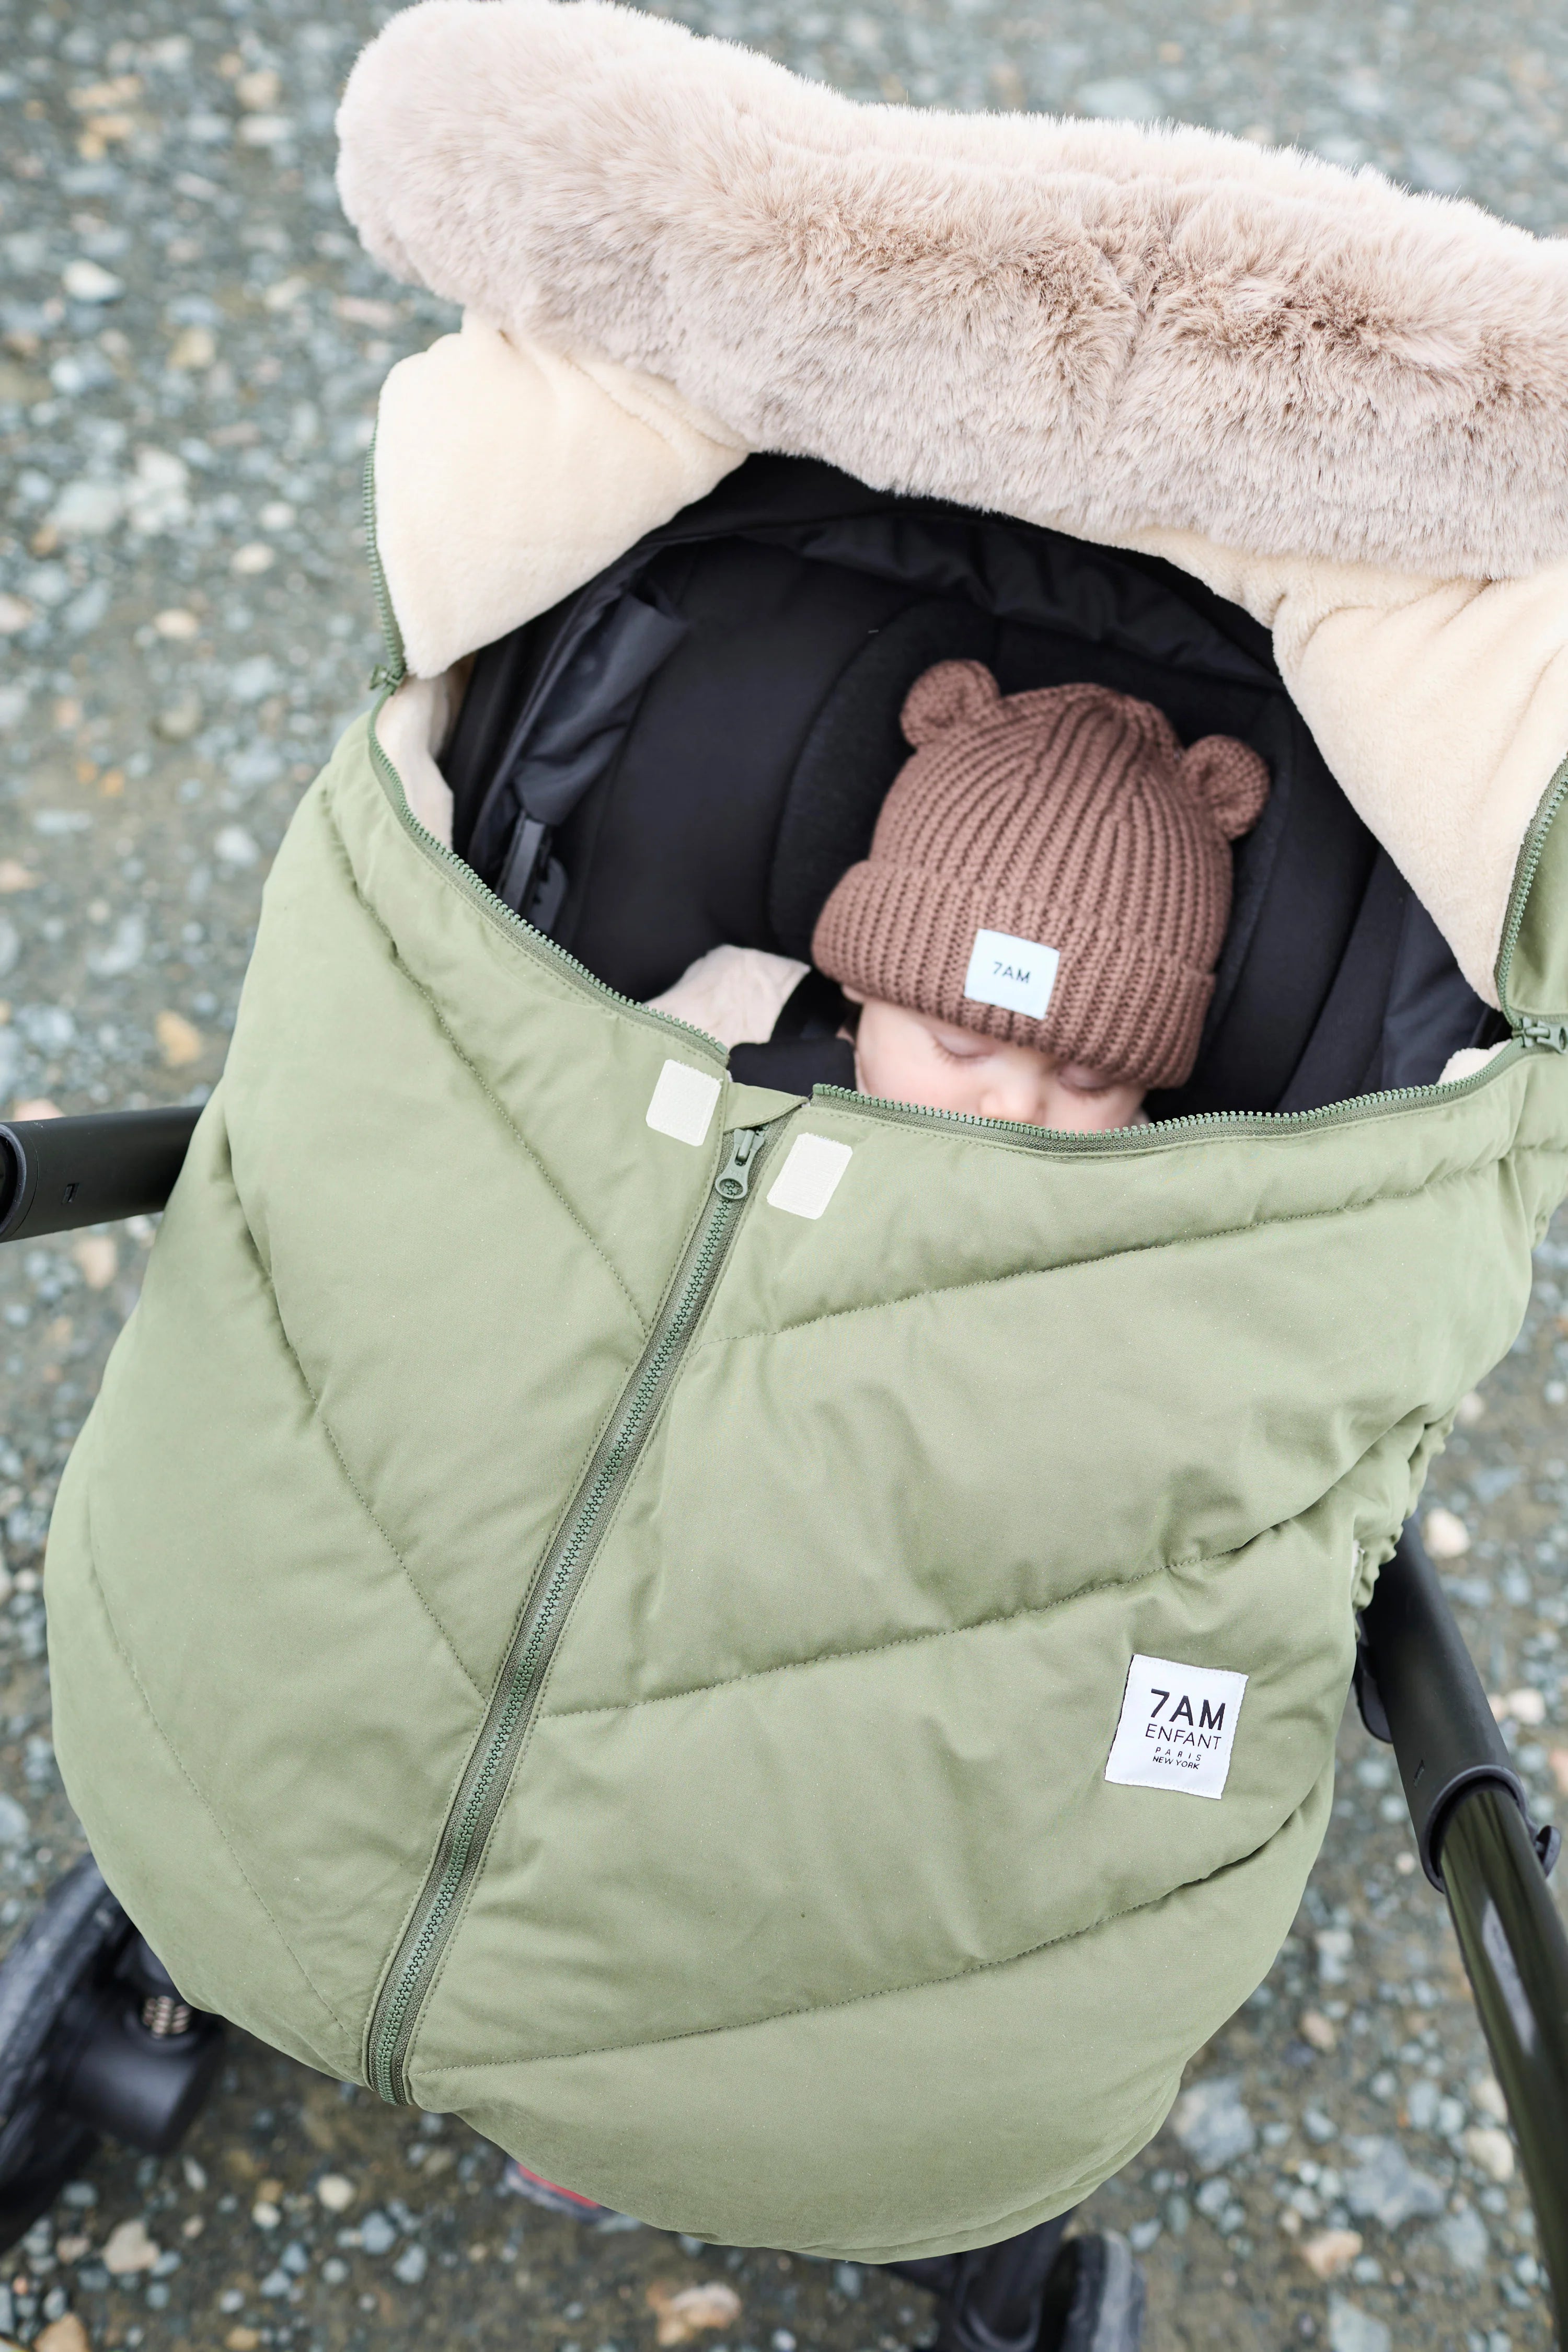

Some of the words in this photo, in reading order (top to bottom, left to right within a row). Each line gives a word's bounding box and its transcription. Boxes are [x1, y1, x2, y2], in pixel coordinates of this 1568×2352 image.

[993, 961, 1031, 984] 7AM
[1150, 1688, 1226, 1731] 7AM
[1145, 1723, 1222, 1750] ENFANT
[1152, 1756, 1174, 1765] NEW
[1176, 1759, 1200, 1770] YORK
[1155, 1747, 1202, 1761] PARIS
